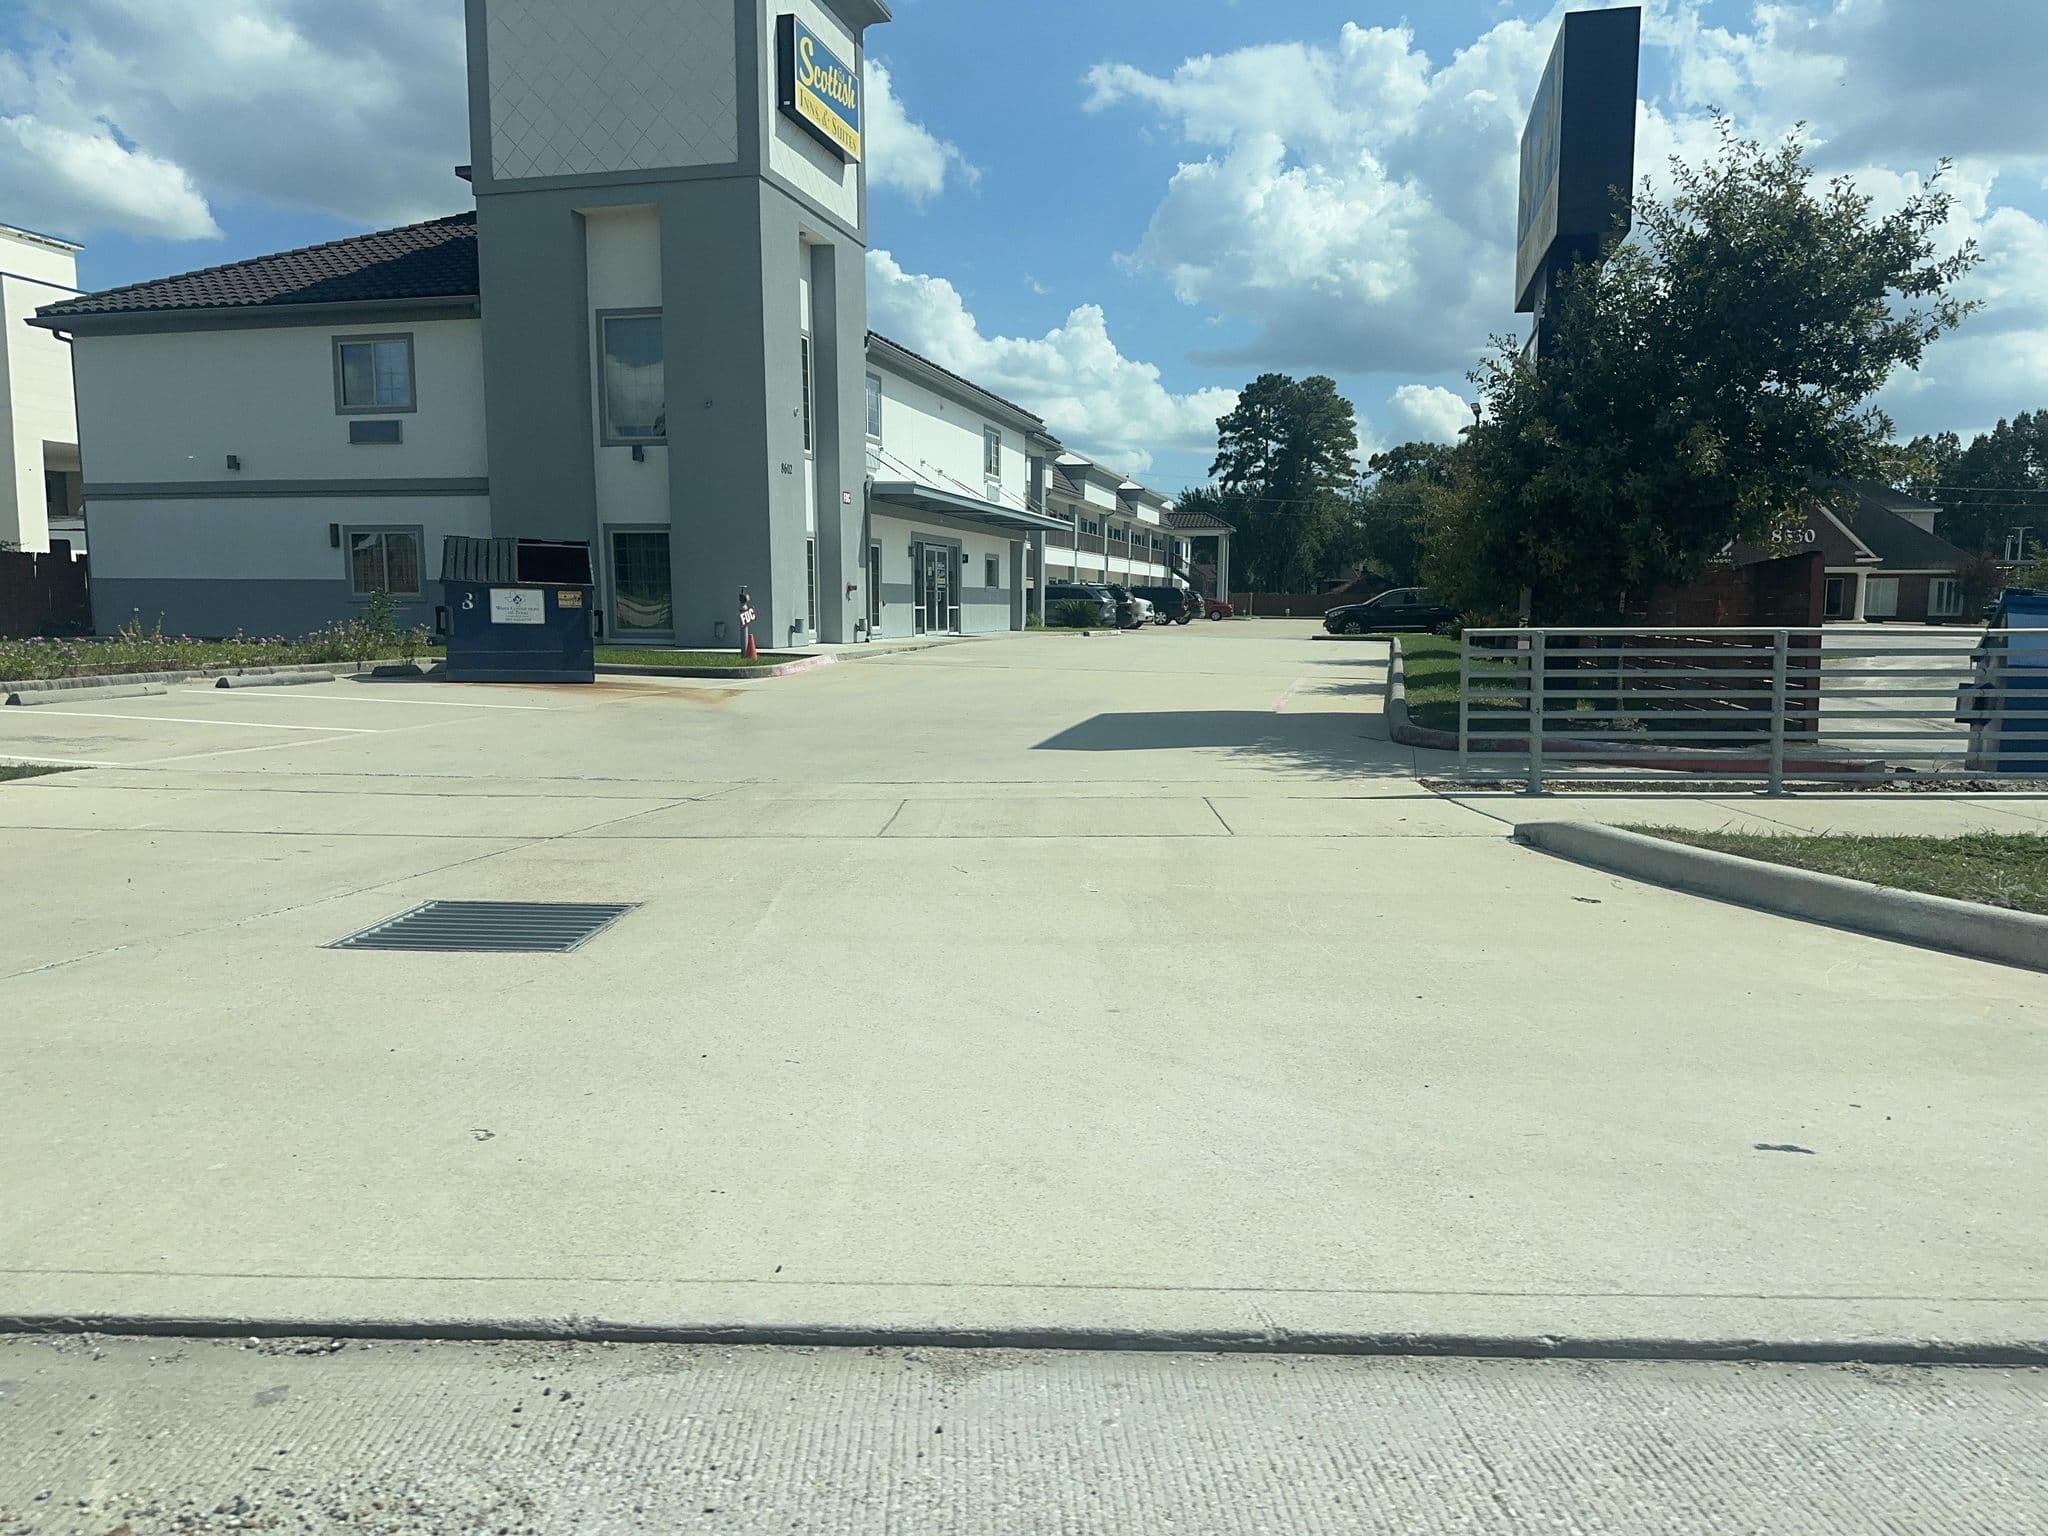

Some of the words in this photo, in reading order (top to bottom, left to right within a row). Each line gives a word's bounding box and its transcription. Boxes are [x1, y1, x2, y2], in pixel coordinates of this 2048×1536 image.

[799, 37, 856, 109] Scottish
[820, 111, 830, 128] &
[740, 608, 756, 625] FDC
